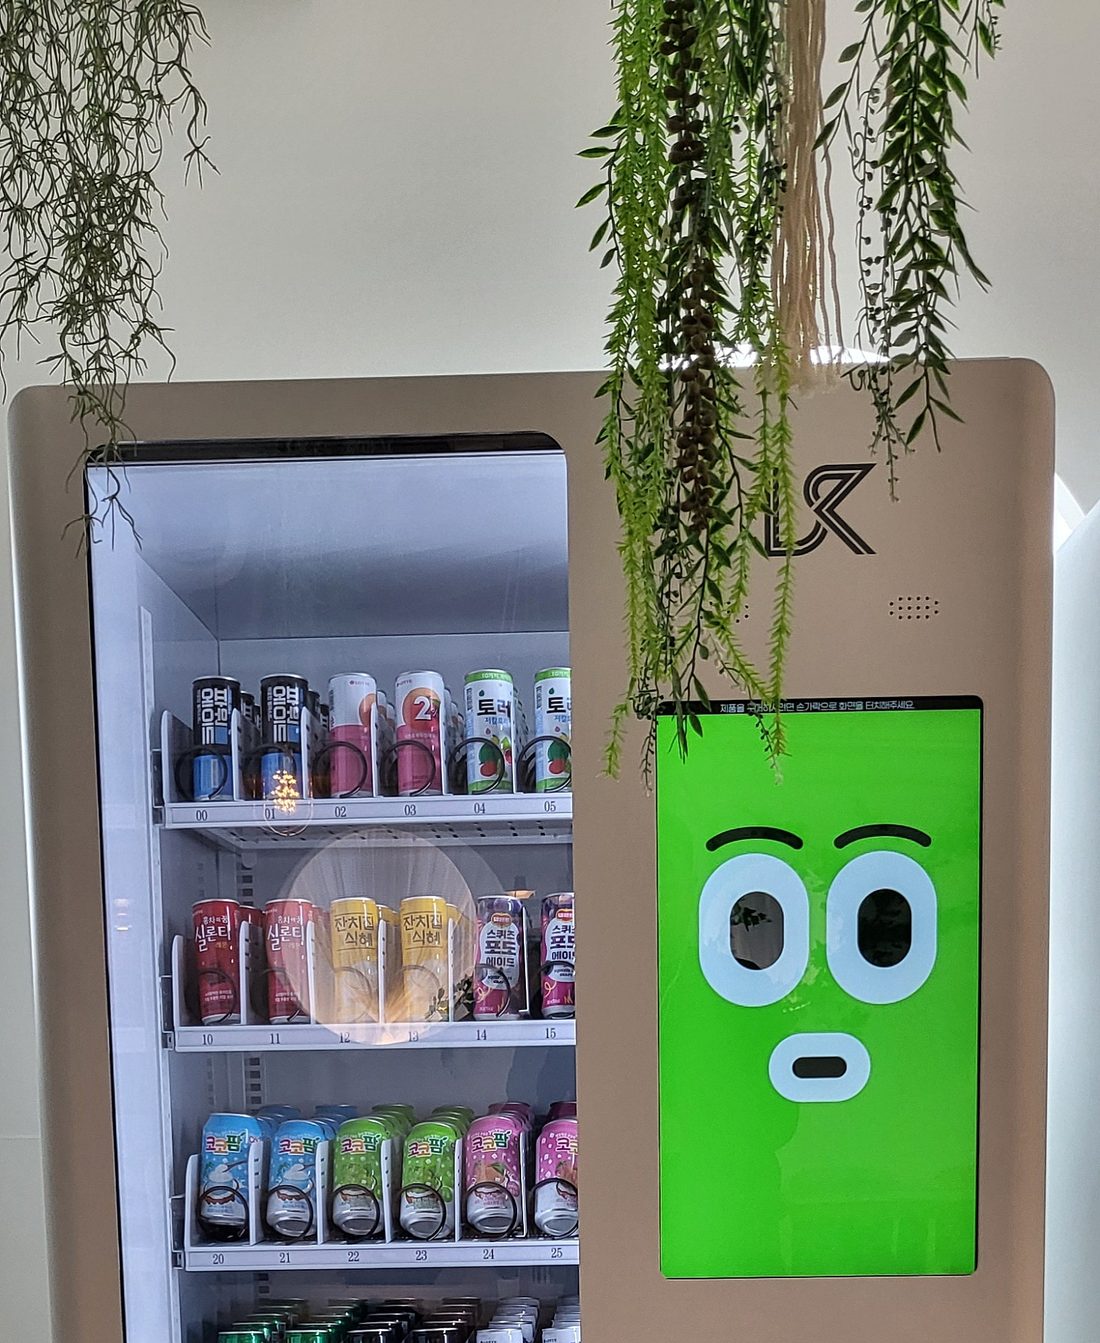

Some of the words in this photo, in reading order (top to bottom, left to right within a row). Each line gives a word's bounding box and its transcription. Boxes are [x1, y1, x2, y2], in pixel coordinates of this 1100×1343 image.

[720, 703, 745, 713] 제품을
[796, 702, 838, 711] 손가락으로
[838, 701, 863, 711] 화면을
[201, 688, 214, 745] 에이드
[273, 686, 286, 743] 에이드
[335, 806, 346, 818] 02
[404, 805, 416, 816] 03
[474, 803, 485, 814] 04
[544, 801, 556, 812] 05
[196, 810, 208, 821] 00
[264, 809, 275, 820] 01
[486, 929, 515, 940] 스퀴즈
[552, 925, 575, 934] 스퀴
[195, 924, 231, 952] 실론티
[267, 923, 304, 951] 실론티
[345, 930, 373, 946] 식혜
[412, 929, 440, 945] 식혜
[485, 940, 517, 955] 포도
[551, 951, 575, 960] 에이
[486, 956, 515, 967] 에이드
[270, 1033, 280, 1044] 11
[340, 1032, 350, 1043] 12
[408, 1031, 418, 1042] 13
[476, 1029, 487, 1041] 14
[545, 1028, 556, 1039] 15
[203, 1034, 213, 1045] 10
[205, 1133, 245, 1154] 코코팜
[341, 1134, 381, 1154] 코코팜
[407, 1136, 449, 1157] 코코팜
[472, 1131, 511, 1152] 코코팜
[280, 1252, 291, 1263] 21
[348, 1251, 359, 1262] 22
[415, 1250, 427, 1261] 23
[483, 1249, 494, 1260] 24
[551, 1247, 562, 1258] 25
[212, 1254, 224, 1265] 20
